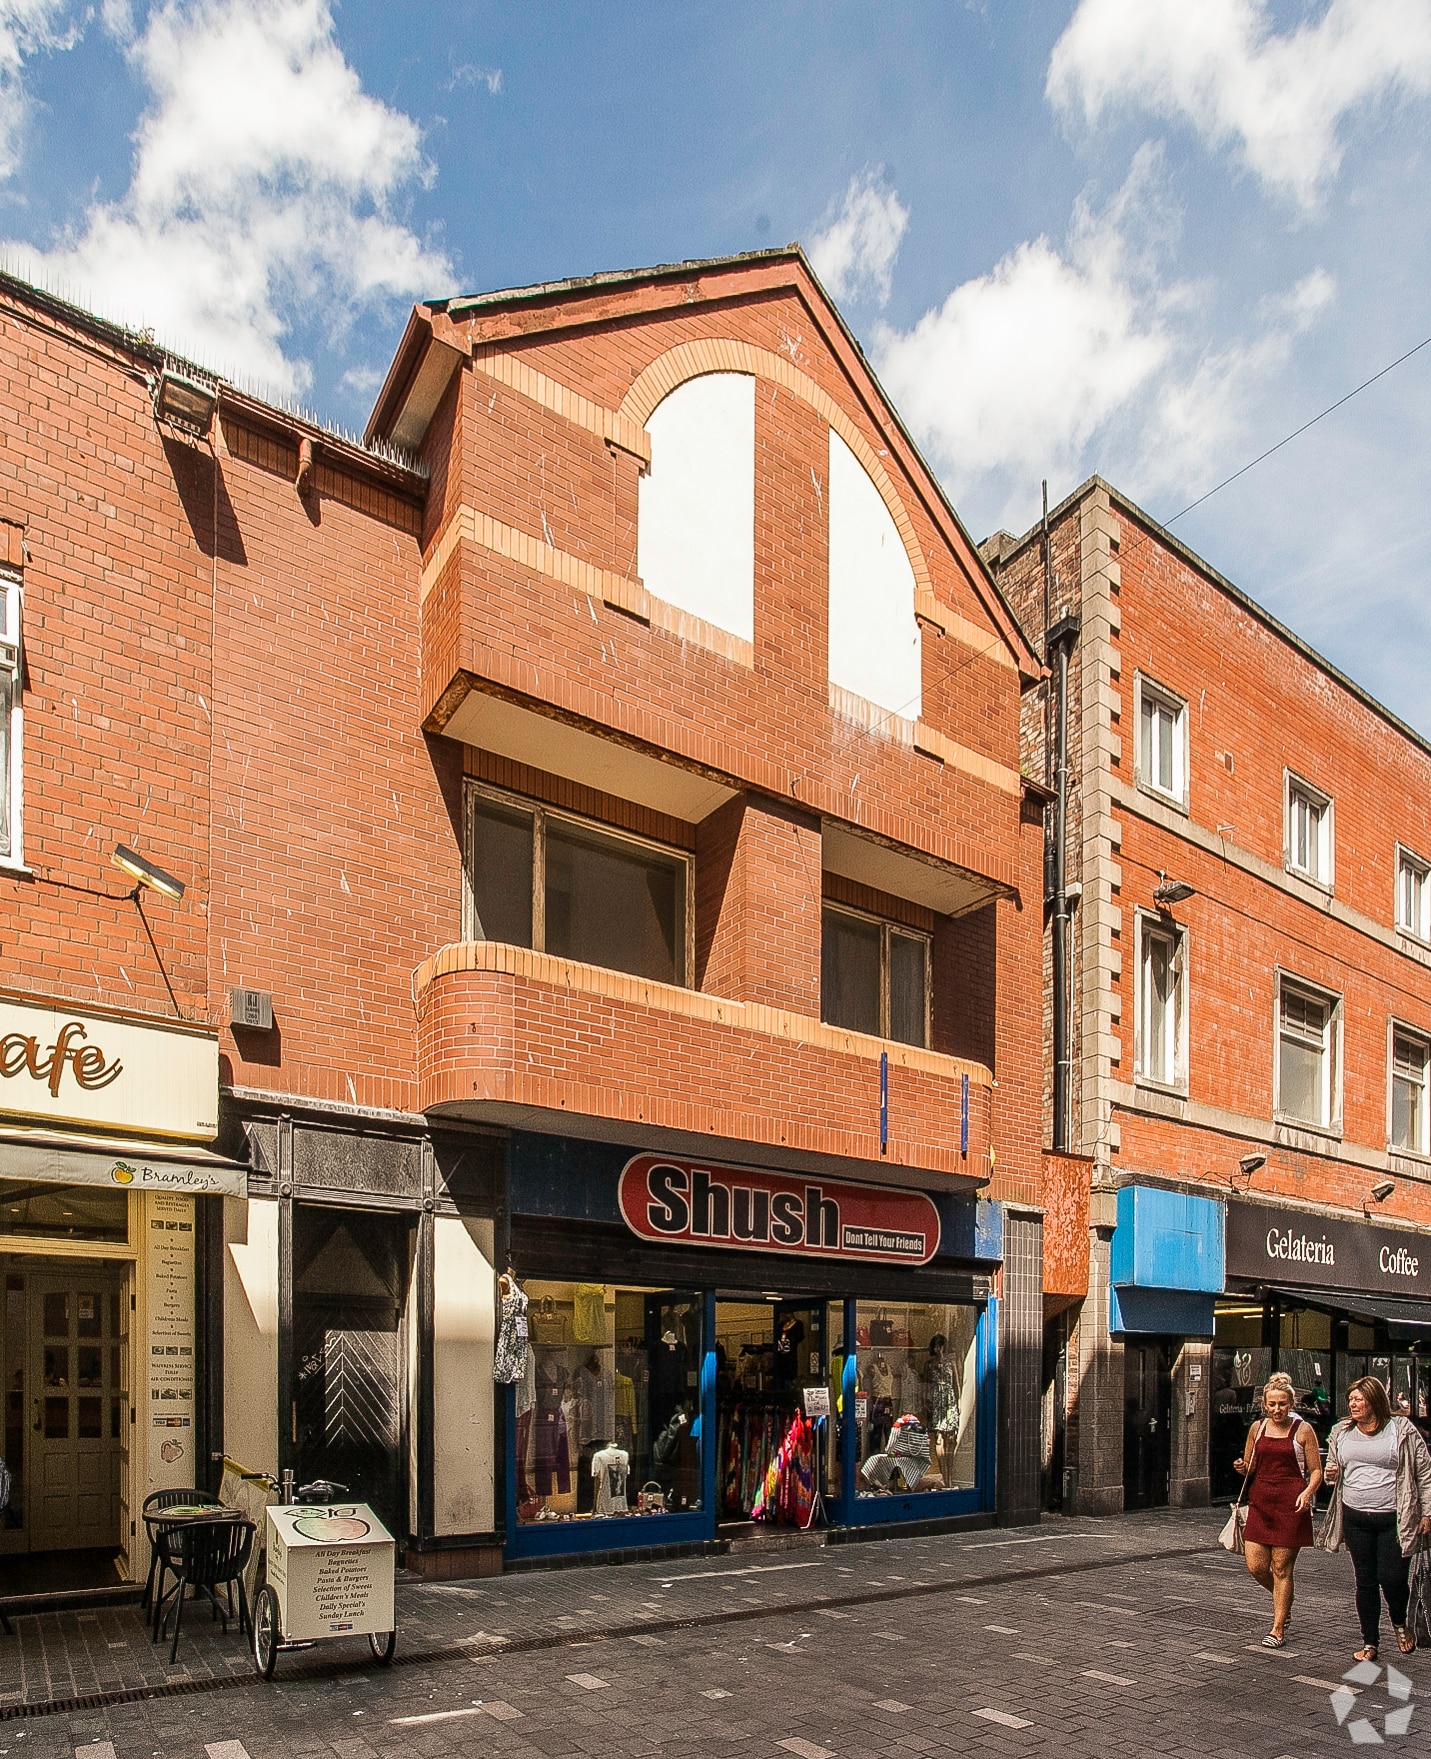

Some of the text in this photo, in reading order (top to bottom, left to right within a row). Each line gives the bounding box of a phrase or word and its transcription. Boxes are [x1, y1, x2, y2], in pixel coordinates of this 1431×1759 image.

[141, 1167, 219, 1190] Bramley's
[646, 1163, 922, 1250] Shush Dont Tell Your Friends
[1267, 1228, 1419, 1277] Gelateria Coffee
[326, 1550, 340, 1558] Day
[340, 1548, 372, 1557] Breakfast
[319, 1567, 340, 1575] Baked
[336, 1575, 342, 1583] &
[343, 1575, 370, 1583] Burgers
[313, 1583, 373, 1594] Selection of Sweets
[315, 1591, 370, 1602] Children's Meals
[320, 1600, 366, 1611] Daily Special's
[318, 1609, 365, 1620] Sunday Lunch
